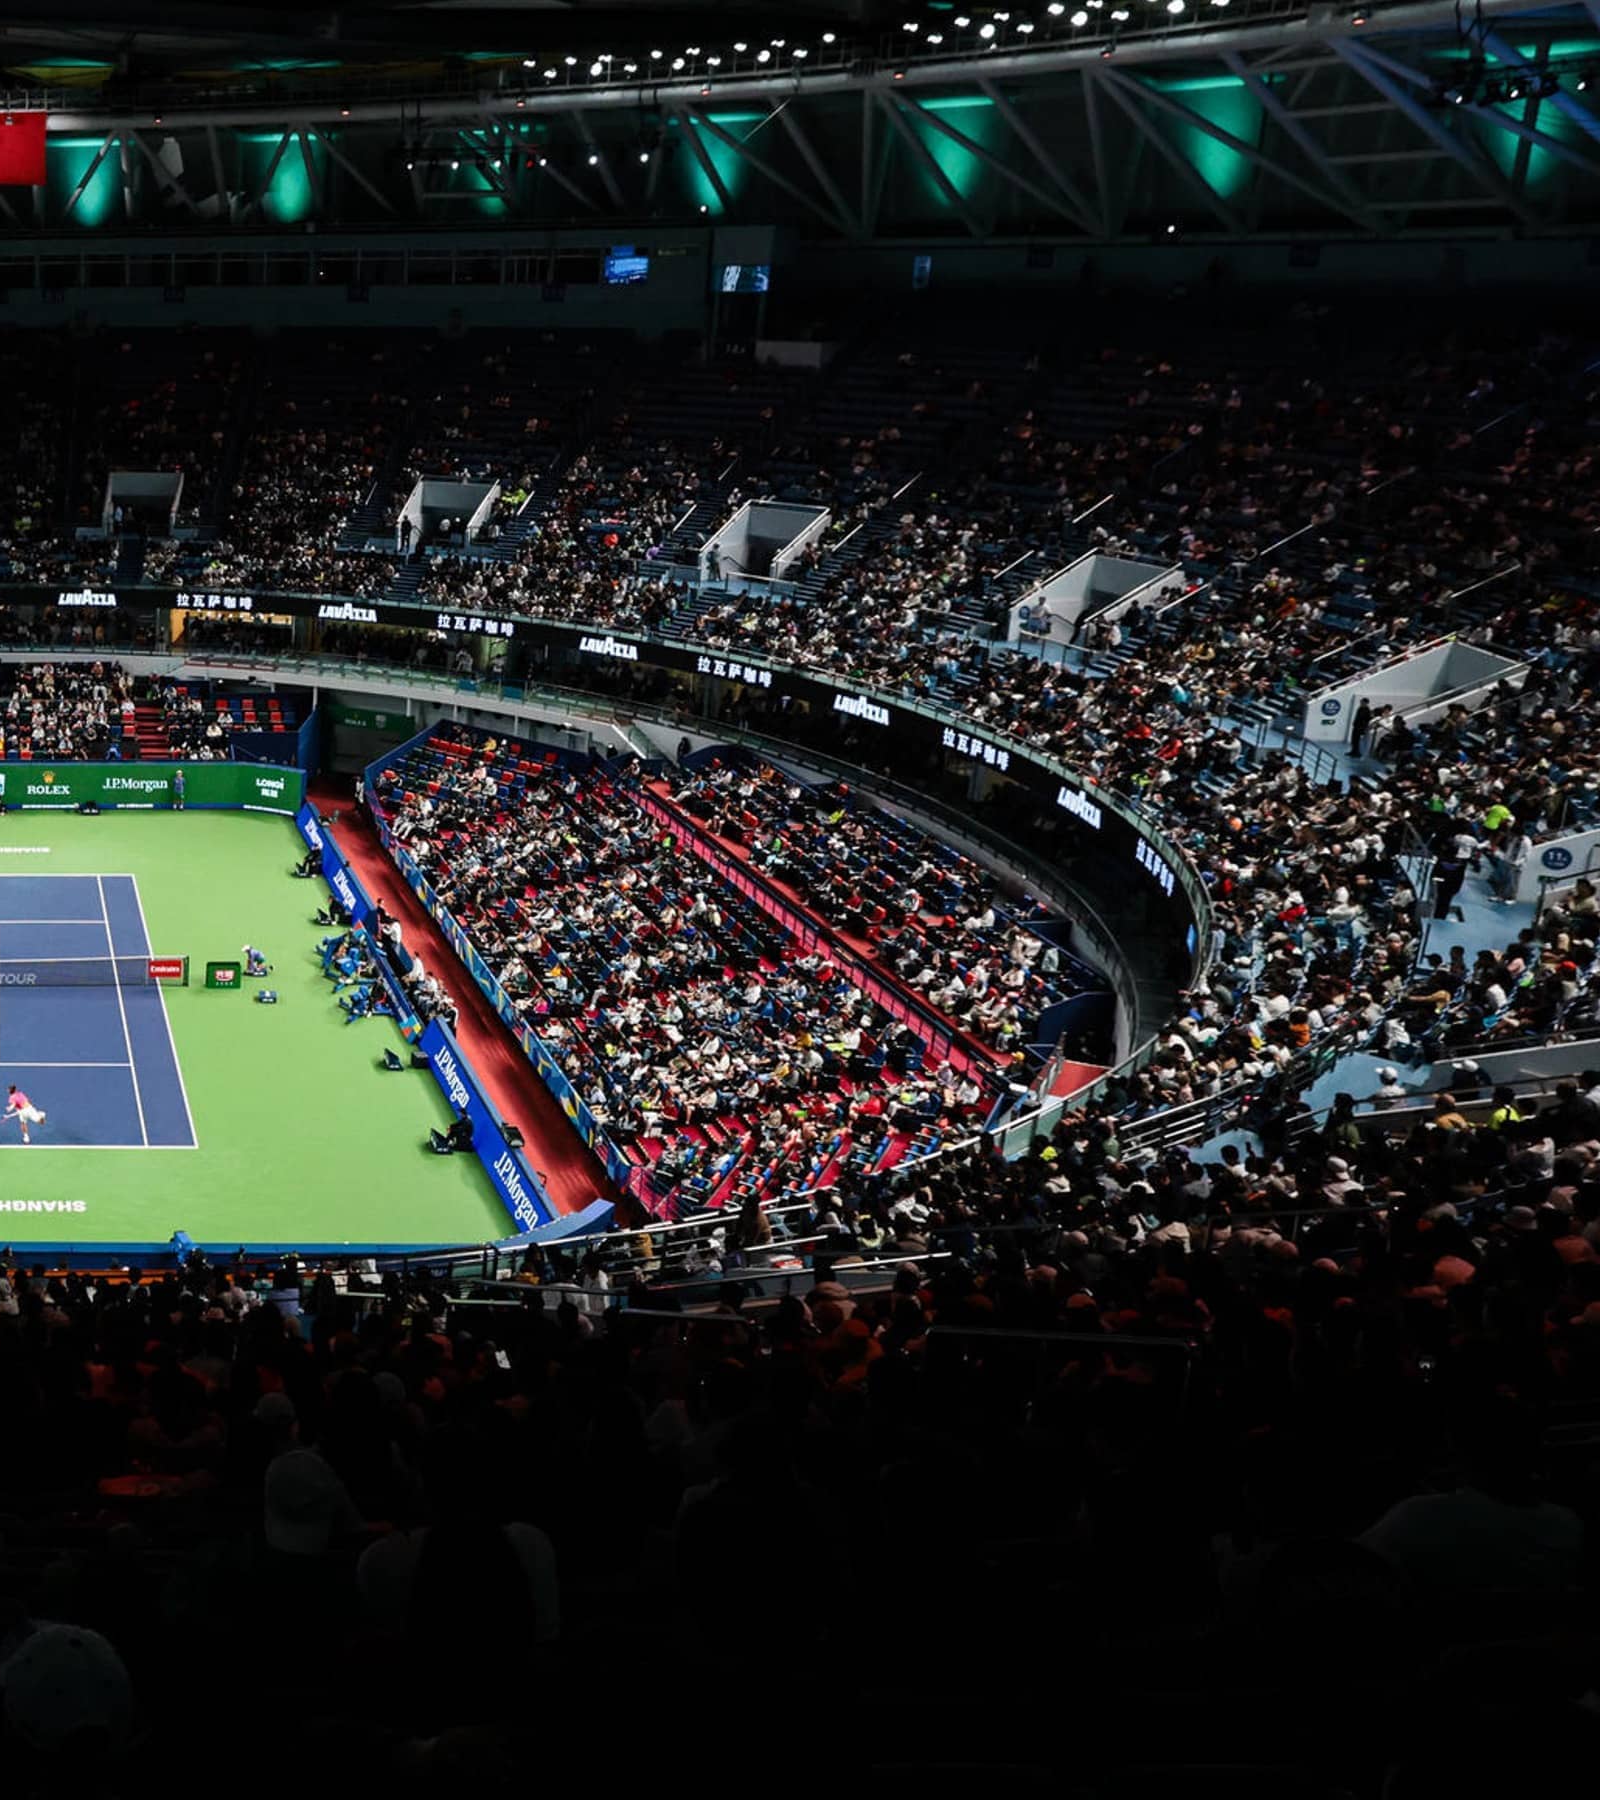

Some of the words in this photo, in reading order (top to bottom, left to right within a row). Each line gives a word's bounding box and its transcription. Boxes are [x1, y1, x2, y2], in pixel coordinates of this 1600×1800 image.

[58, 589, 117, 607] LAVAZZA
[318, 602, 378, 623] LAVAZZA
[579, 633, 638, 660] LAVAZZA
[27, 785, 70, 795] ROLEX
[103, 777, 168, 793] J.P.Morgan
[434, 1045, 471, 1108] J.P.Morgan
[494, 1152, 540, 1231] J.P.Morgan
